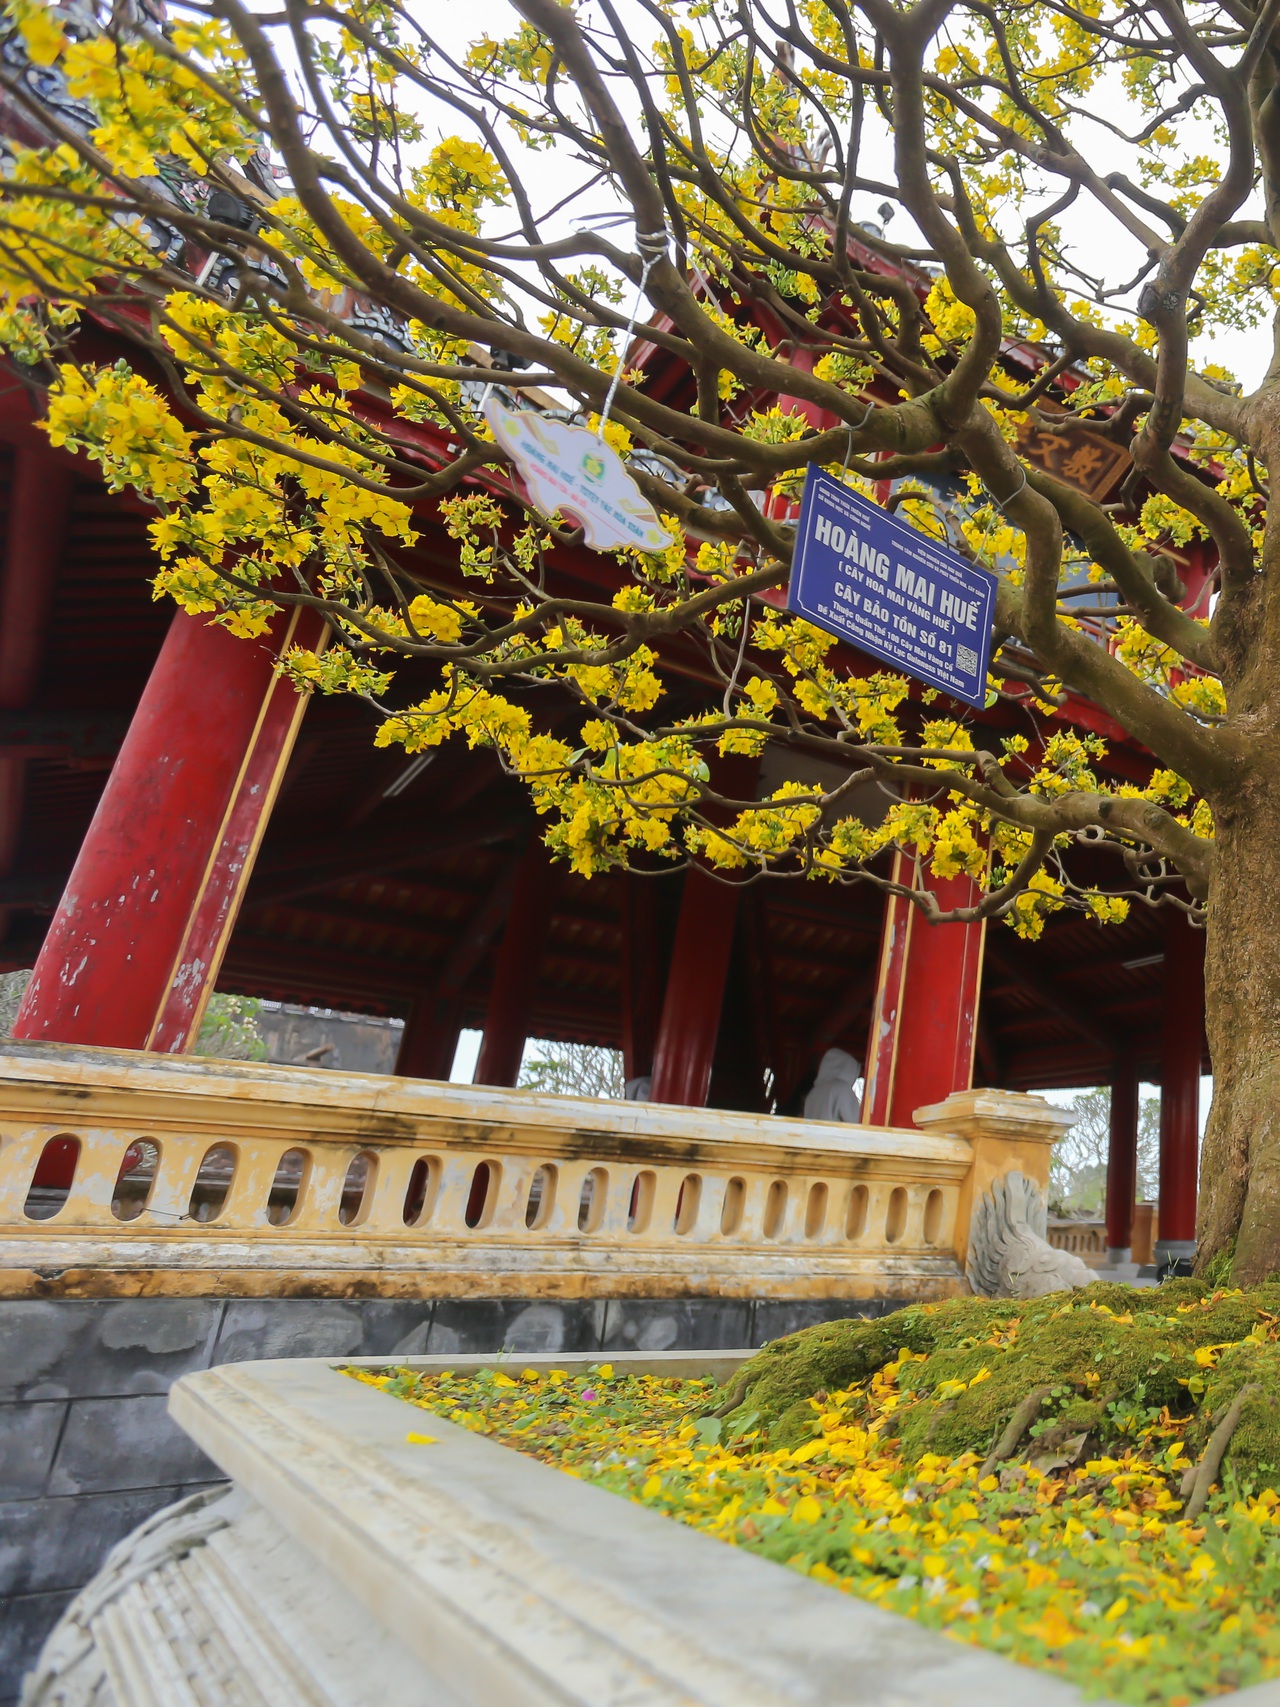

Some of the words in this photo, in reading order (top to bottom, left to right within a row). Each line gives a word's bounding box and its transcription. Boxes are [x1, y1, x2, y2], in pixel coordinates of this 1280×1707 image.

[815, 514, 890, 581] HOÀNG
[895, 563, 935, 607] MAI
[939, 589, 981, 631] HUẾ
[845, 564, 864, 582] CÂY
[865, 576, 884, 595] HOA
[886, 588, 905, 607] MAI
[907, 600, 931, 621] VÀNG
[932, 614, 951, 632] HUẾ
[833, 600, 854, 618] Thuộc
[914, 645, 927, 658] Mai
[834, 582, 860, 606] CÂY
[863, 598, 889, 622] BẢO
[919, 630, 937, 648] SỐ
[939, 640, 952, 657] 81
[950, 675, 964, 688] Nam
